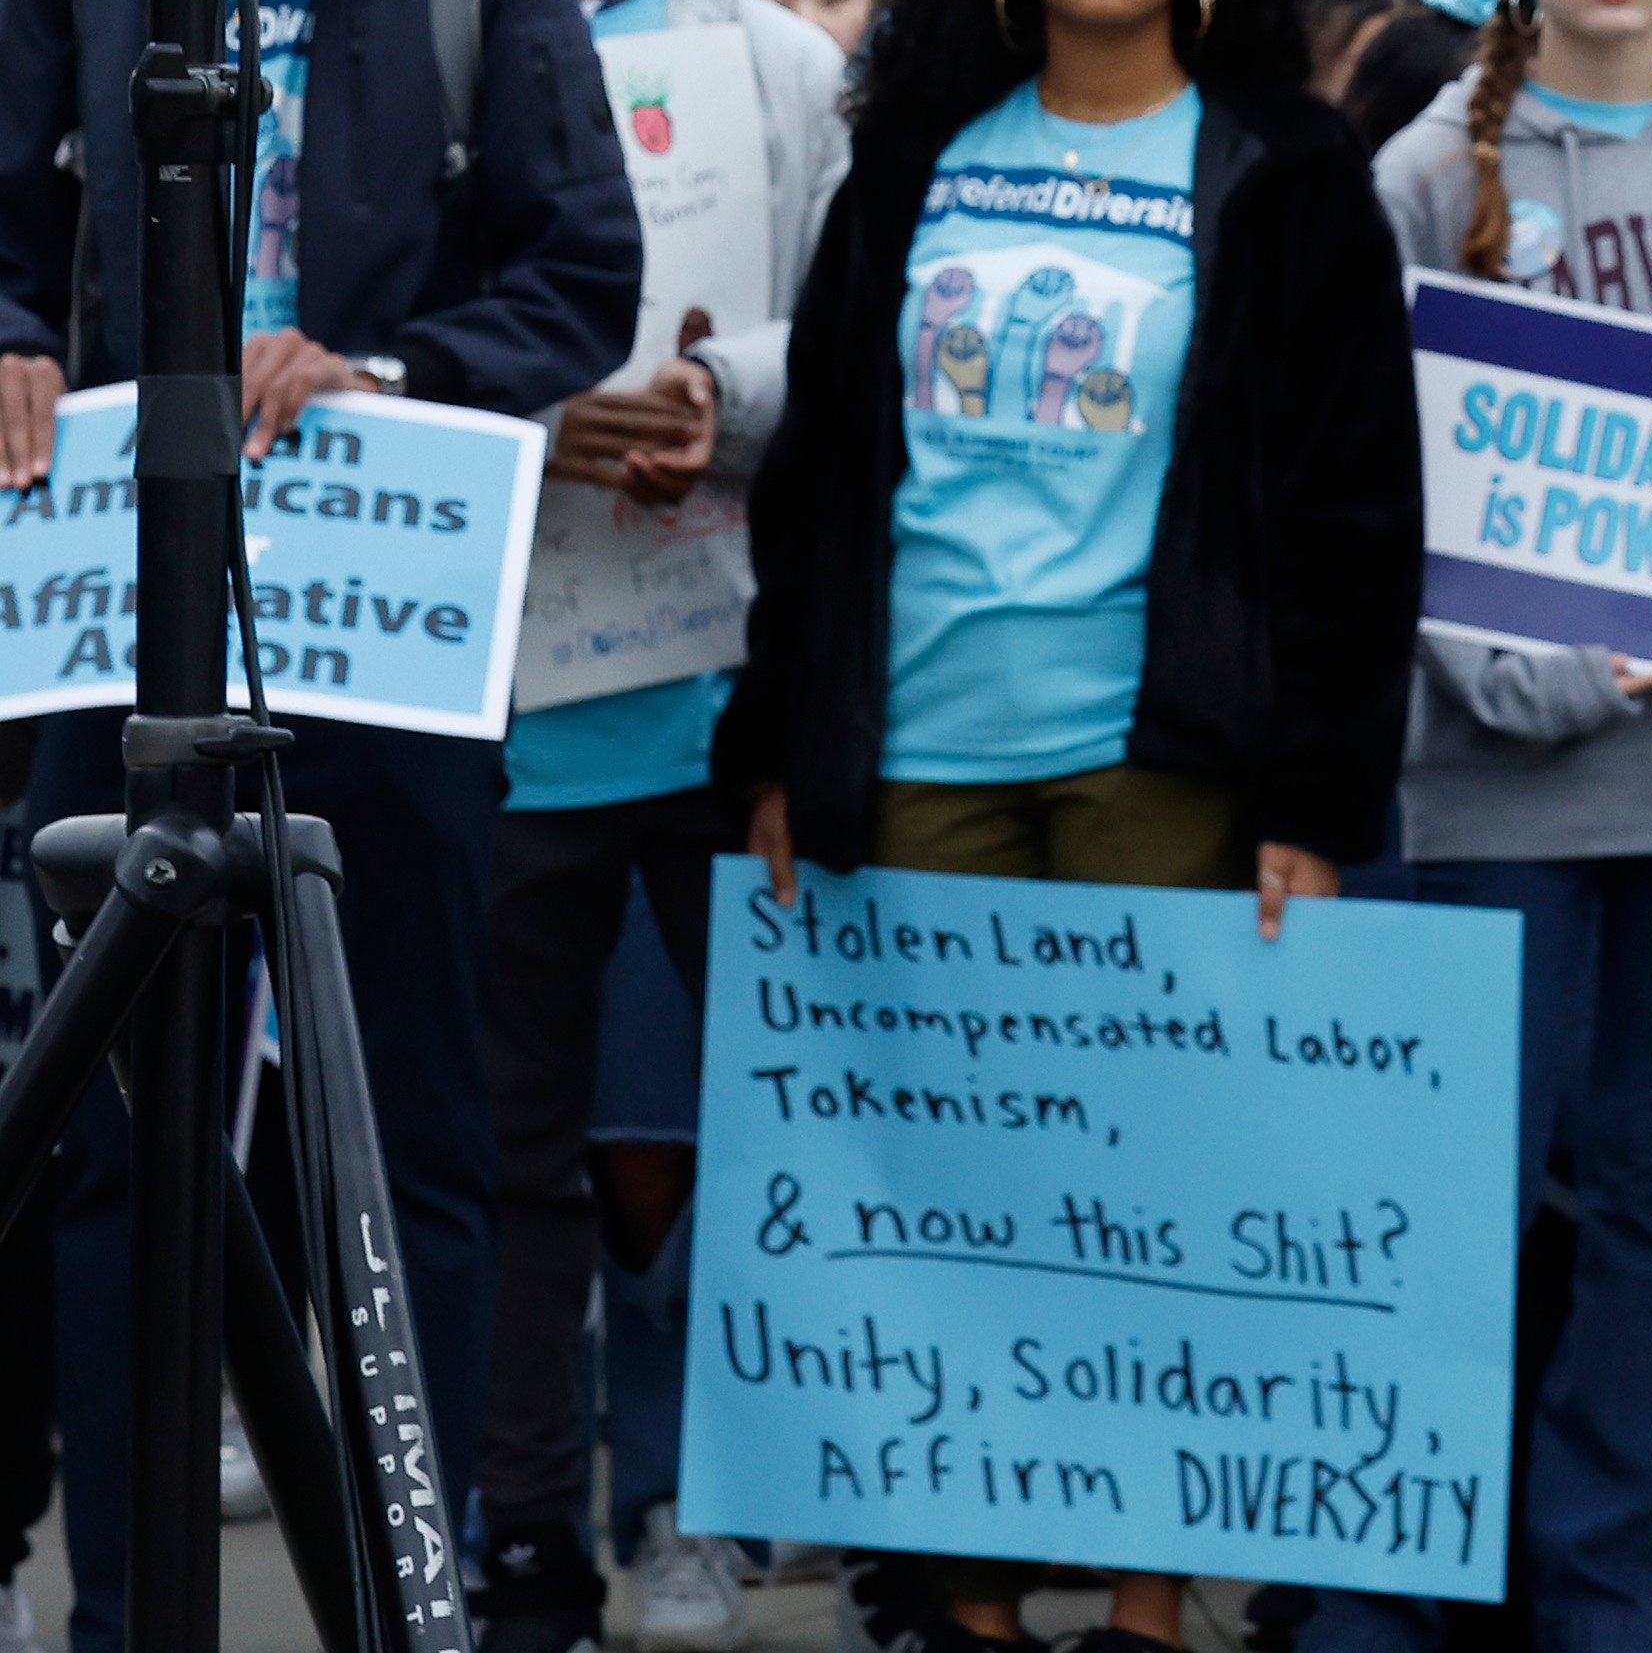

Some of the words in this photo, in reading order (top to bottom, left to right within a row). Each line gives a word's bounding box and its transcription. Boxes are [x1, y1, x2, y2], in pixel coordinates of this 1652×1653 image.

[5, 460, 470, 534] Amicans
[1482, 474, 1526, 548] is
[747, 888, 975, 964] Stolen
[991, 908, 1178, 996] Land,
[757, 977, 1231, 1059] Uncompensated
[1265, 1019, 1443, 1090] Labor,
[750, 1065, 1121, 1148] Tokenism,
[755, 1171, 813, 1257] &
[854, 1197, 1019, 1249] now
[1052, 1192, 1186, 1269] this
[1230, 1197, 1412, 1289] Shit?
[720, 1299, 982, 1425] Unity,
[1010, 1338, 1442, 1474] Solidarity,
[350, 1304, 426, 1626] SUPPORT
[1174, 1447, 1480, 1566] DIVERSITY
